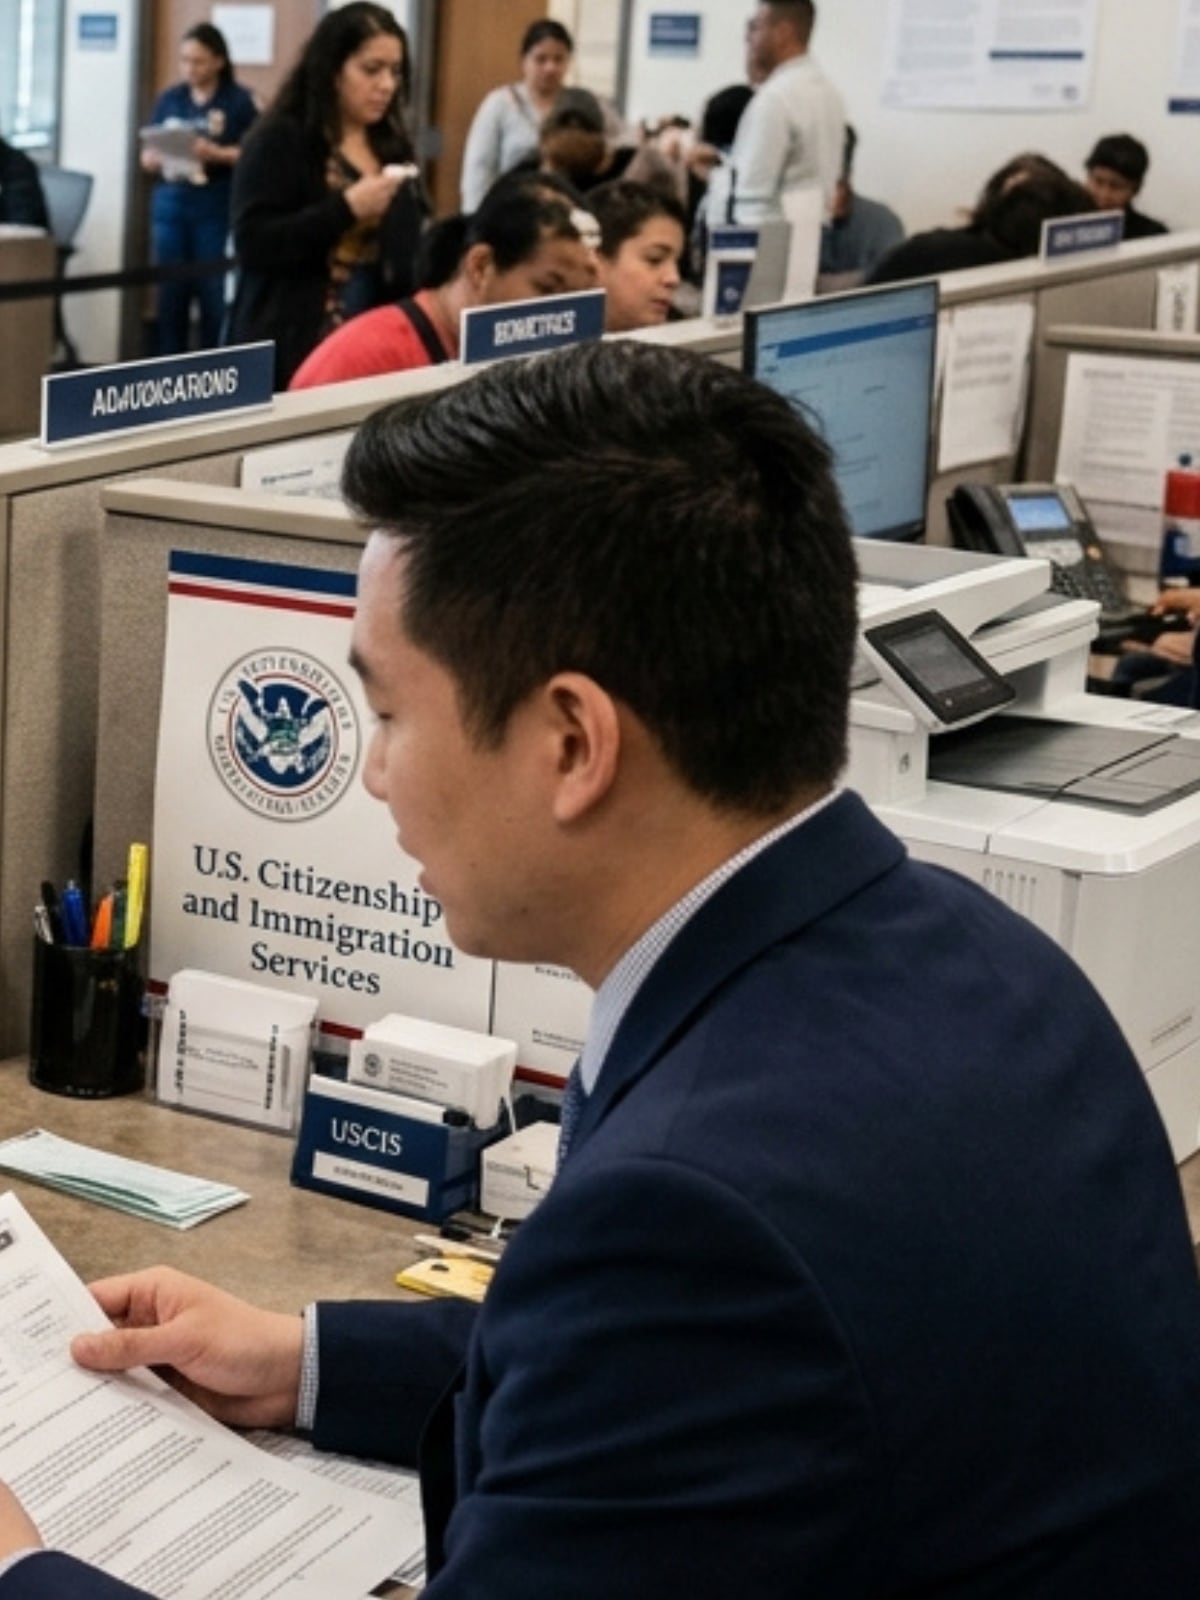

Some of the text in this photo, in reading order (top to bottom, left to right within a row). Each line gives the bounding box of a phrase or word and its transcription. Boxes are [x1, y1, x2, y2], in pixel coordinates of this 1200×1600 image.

[194, 845, 442, 927] U.S. Citizenship
[182, 893, 454, 968] and Immigration
[251, 942, 381, 995] Services
[331, 1117, 403, 1156] USCIS
